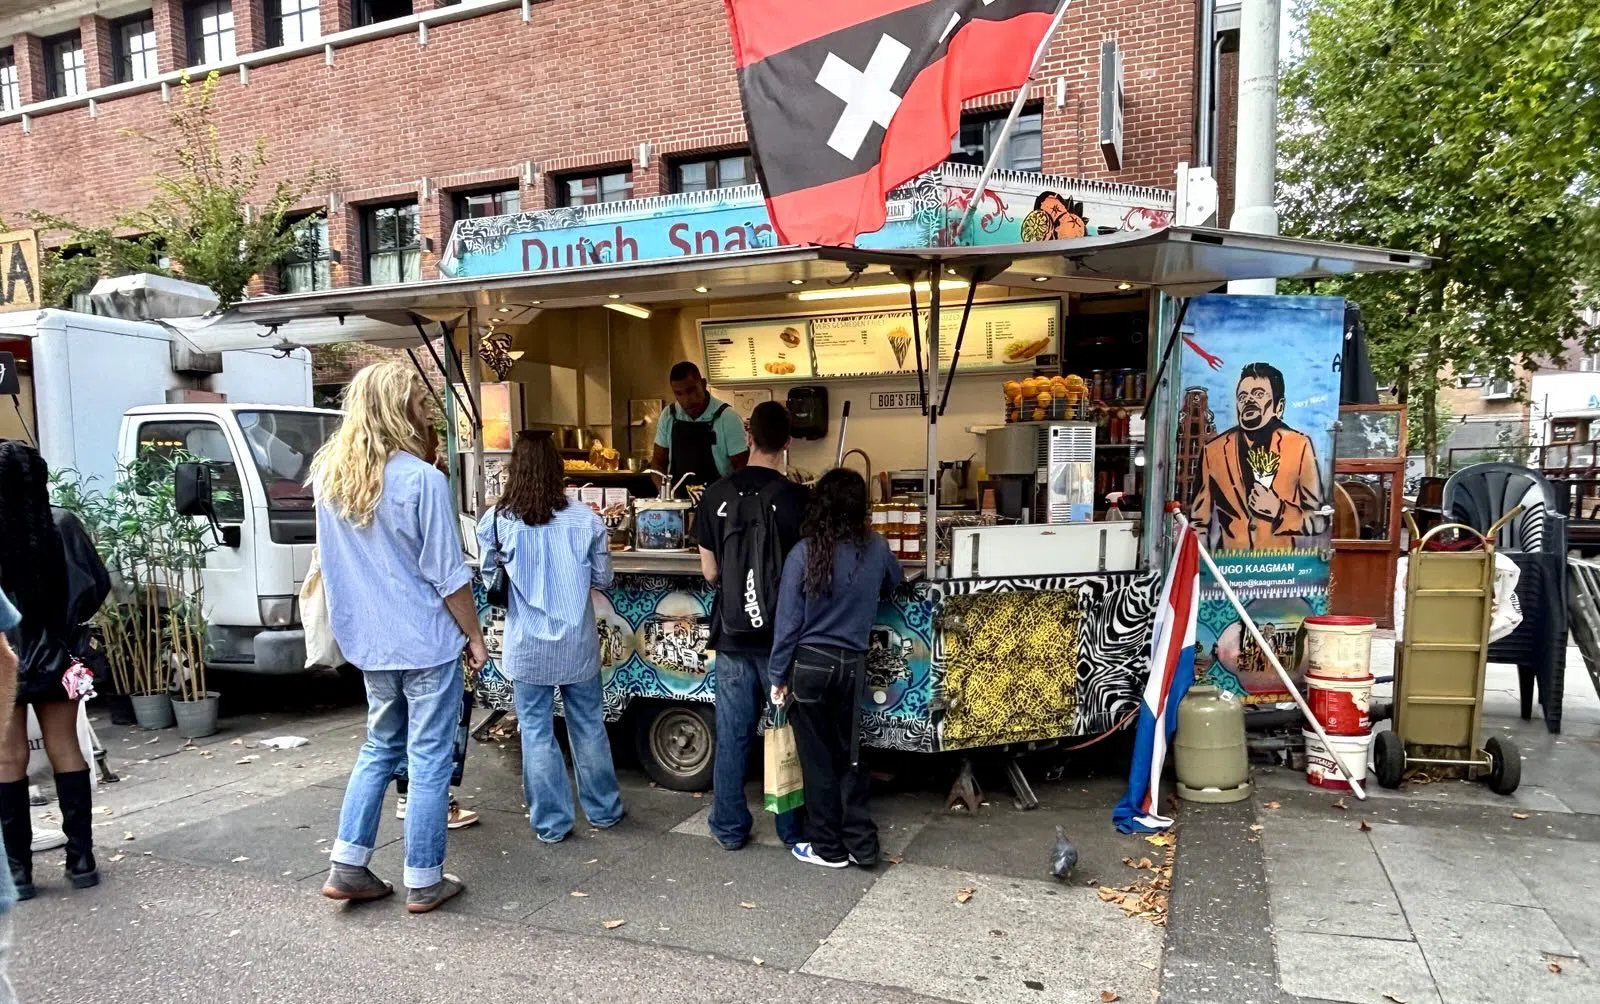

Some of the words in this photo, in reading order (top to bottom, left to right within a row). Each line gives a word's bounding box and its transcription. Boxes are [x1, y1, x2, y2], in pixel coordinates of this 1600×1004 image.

[878, 394, 904, 407] BOB'S
[905, 393, 928, 407] FRI
[1245, 563, 1295, 574] KAAGMAN
[744, 568, 764, 628] adidas
